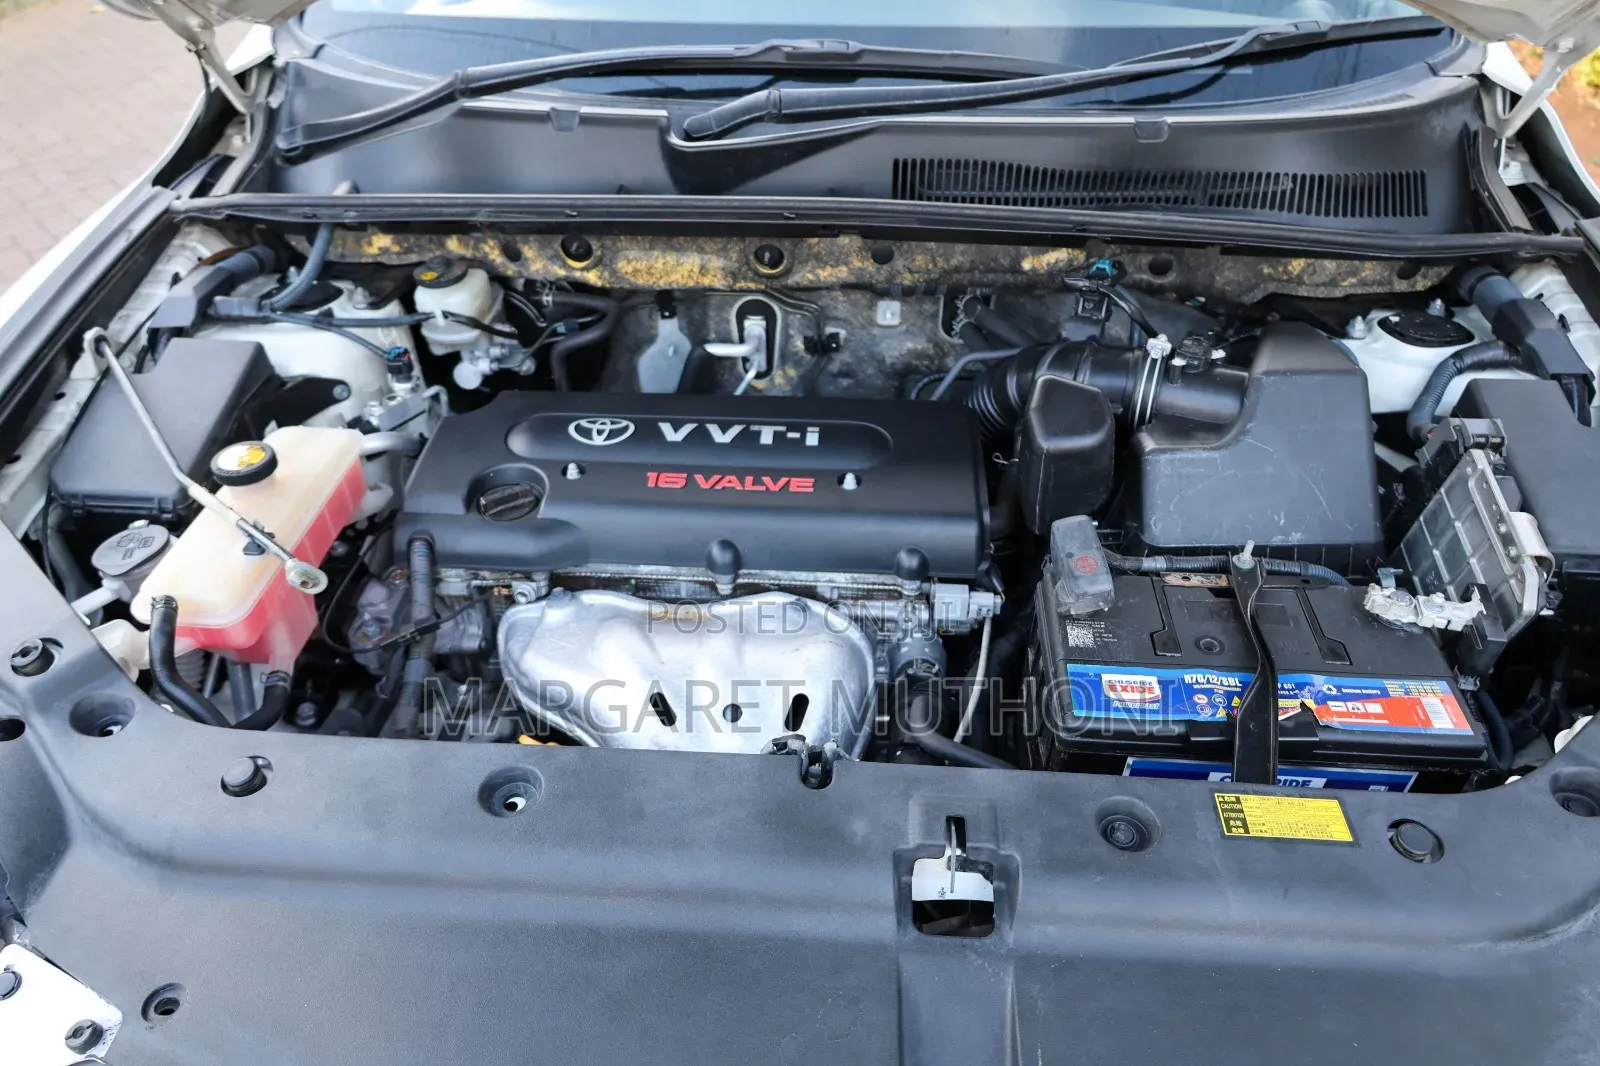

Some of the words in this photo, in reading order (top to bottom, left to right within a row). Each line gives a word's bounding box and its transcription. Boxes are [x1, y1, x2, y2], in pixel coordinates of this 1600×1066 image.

[657, 421, 820, 447] VVT-i
[646, 471, 688, 489] 16
[694, 473, 815, 494] VALVE
[1107, 679, 1153, 687] CHLORIDE
[1108, 684, 1156, 695] EXIDE
